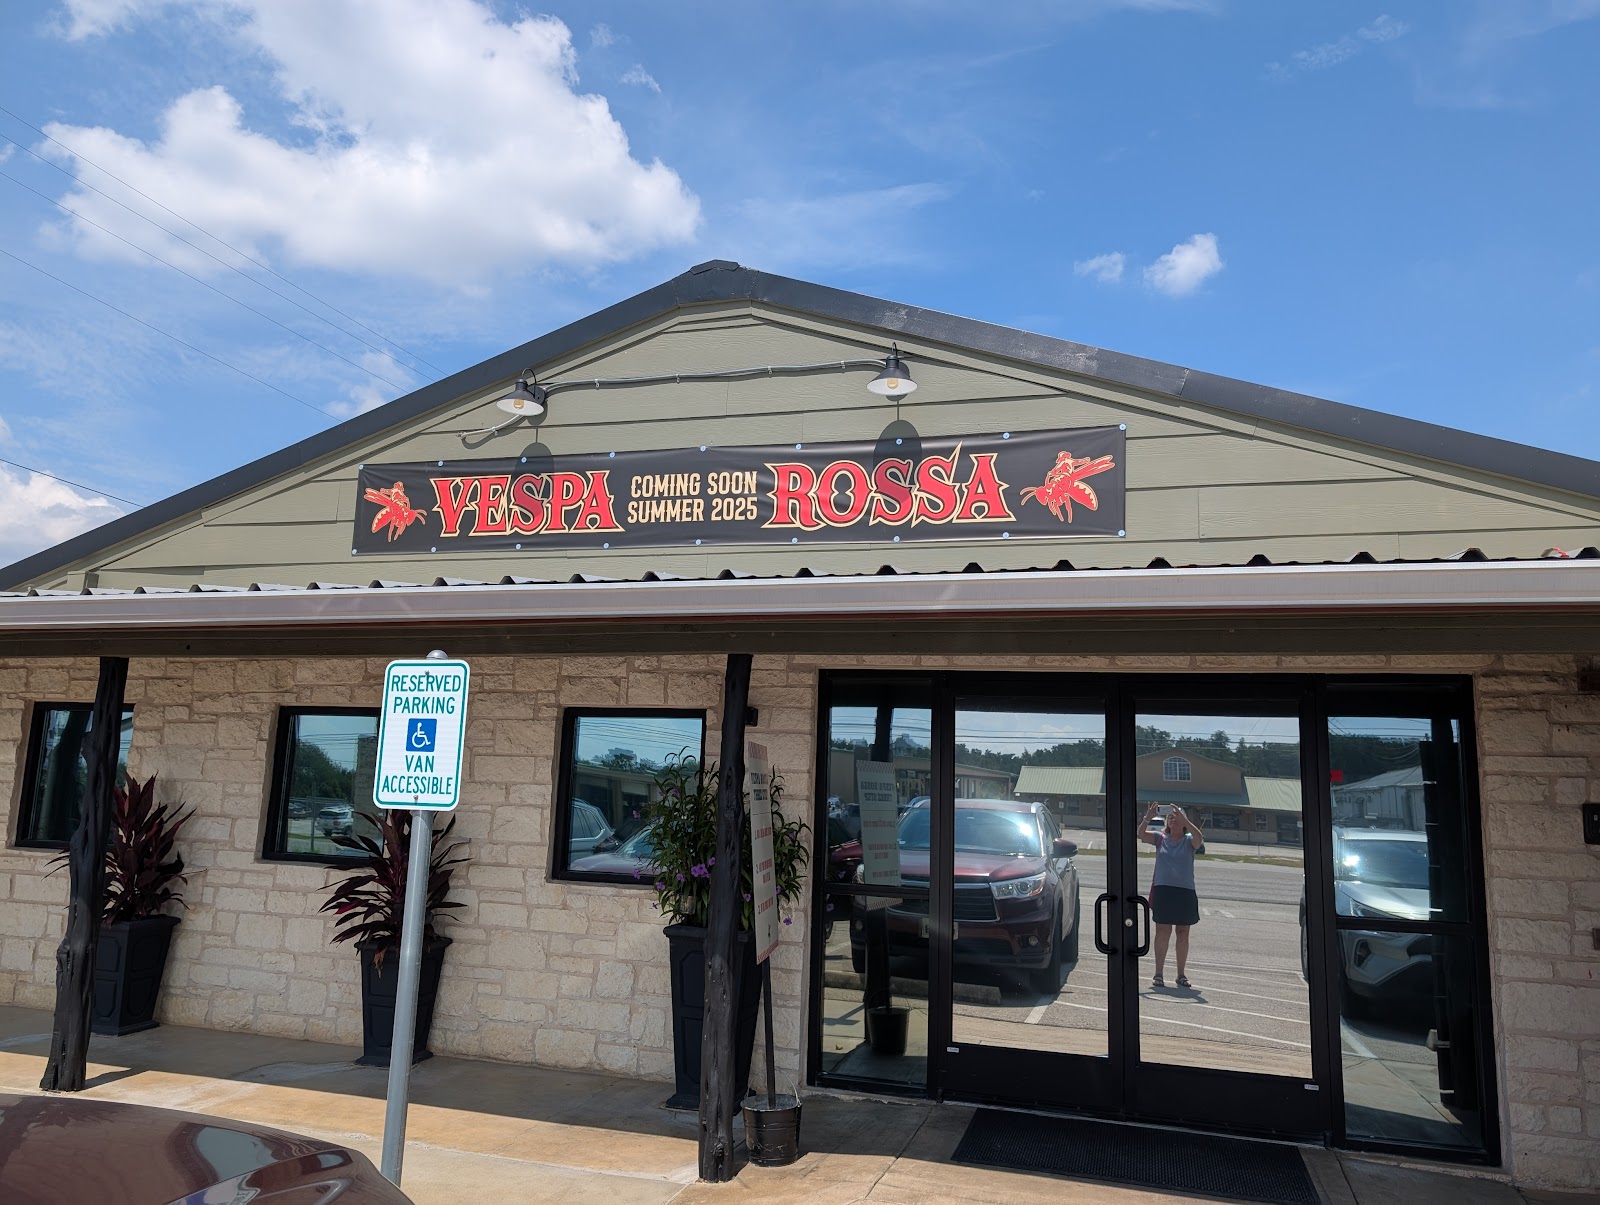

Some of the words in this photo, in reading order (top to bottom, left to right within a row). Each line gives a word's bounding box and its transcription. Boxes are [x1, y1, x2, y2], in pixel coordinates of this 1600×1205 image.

[430, 470, 625, 537] VESPA
[761, 441, 1016, 531] ROSSA
[631, 473, 701, 498] COMING
[707, 471, 758, 495] SOON
[627, 499, 704, 523] SUMMER
[711, 497, 758, 521] 2025
[391, 675, 461, 692] RESERVED
[393, 696, 455, 714] PARKING
[405, 755, 434, 773] VAN
[382, 775, 453, 795] ACCESSIBLE
